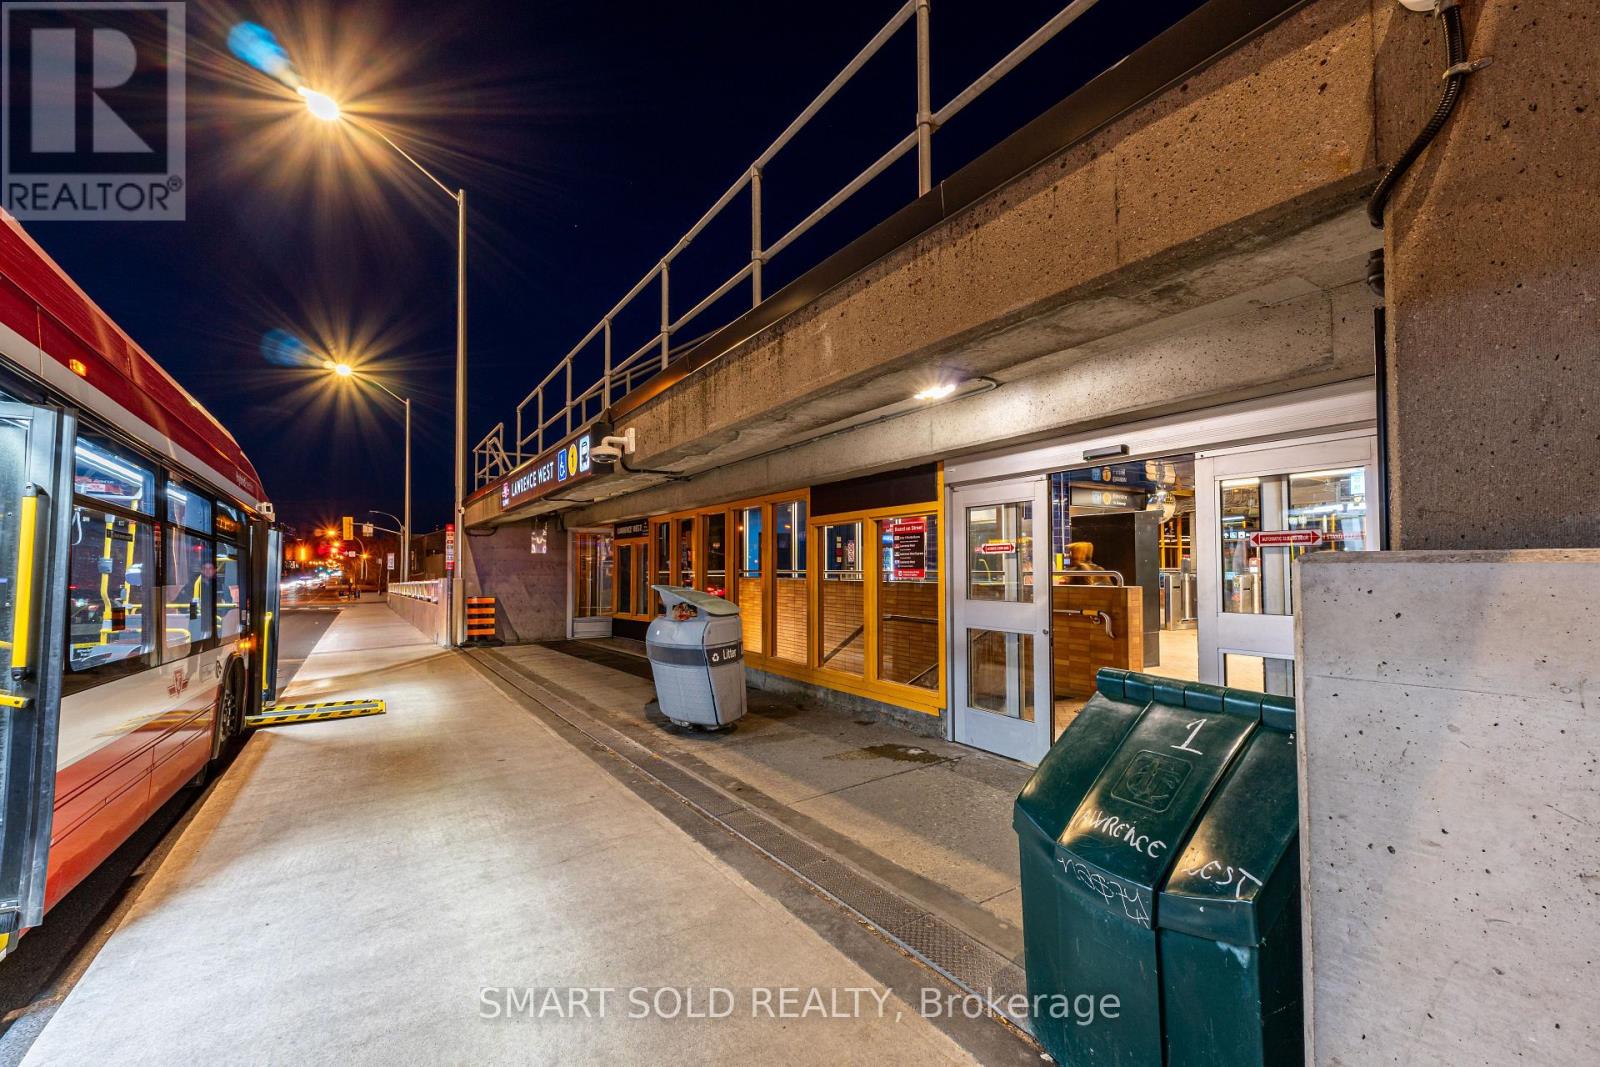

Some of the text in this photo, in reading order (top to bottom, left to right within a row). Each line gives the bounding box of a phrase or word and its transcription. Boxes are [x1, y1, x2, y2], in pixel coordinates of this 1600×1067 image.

[511, 461, 554, 497] LAWRENCE WEST
[722, 648, 737, 660] Litter
[1170, 718, 1207, 755] 1
